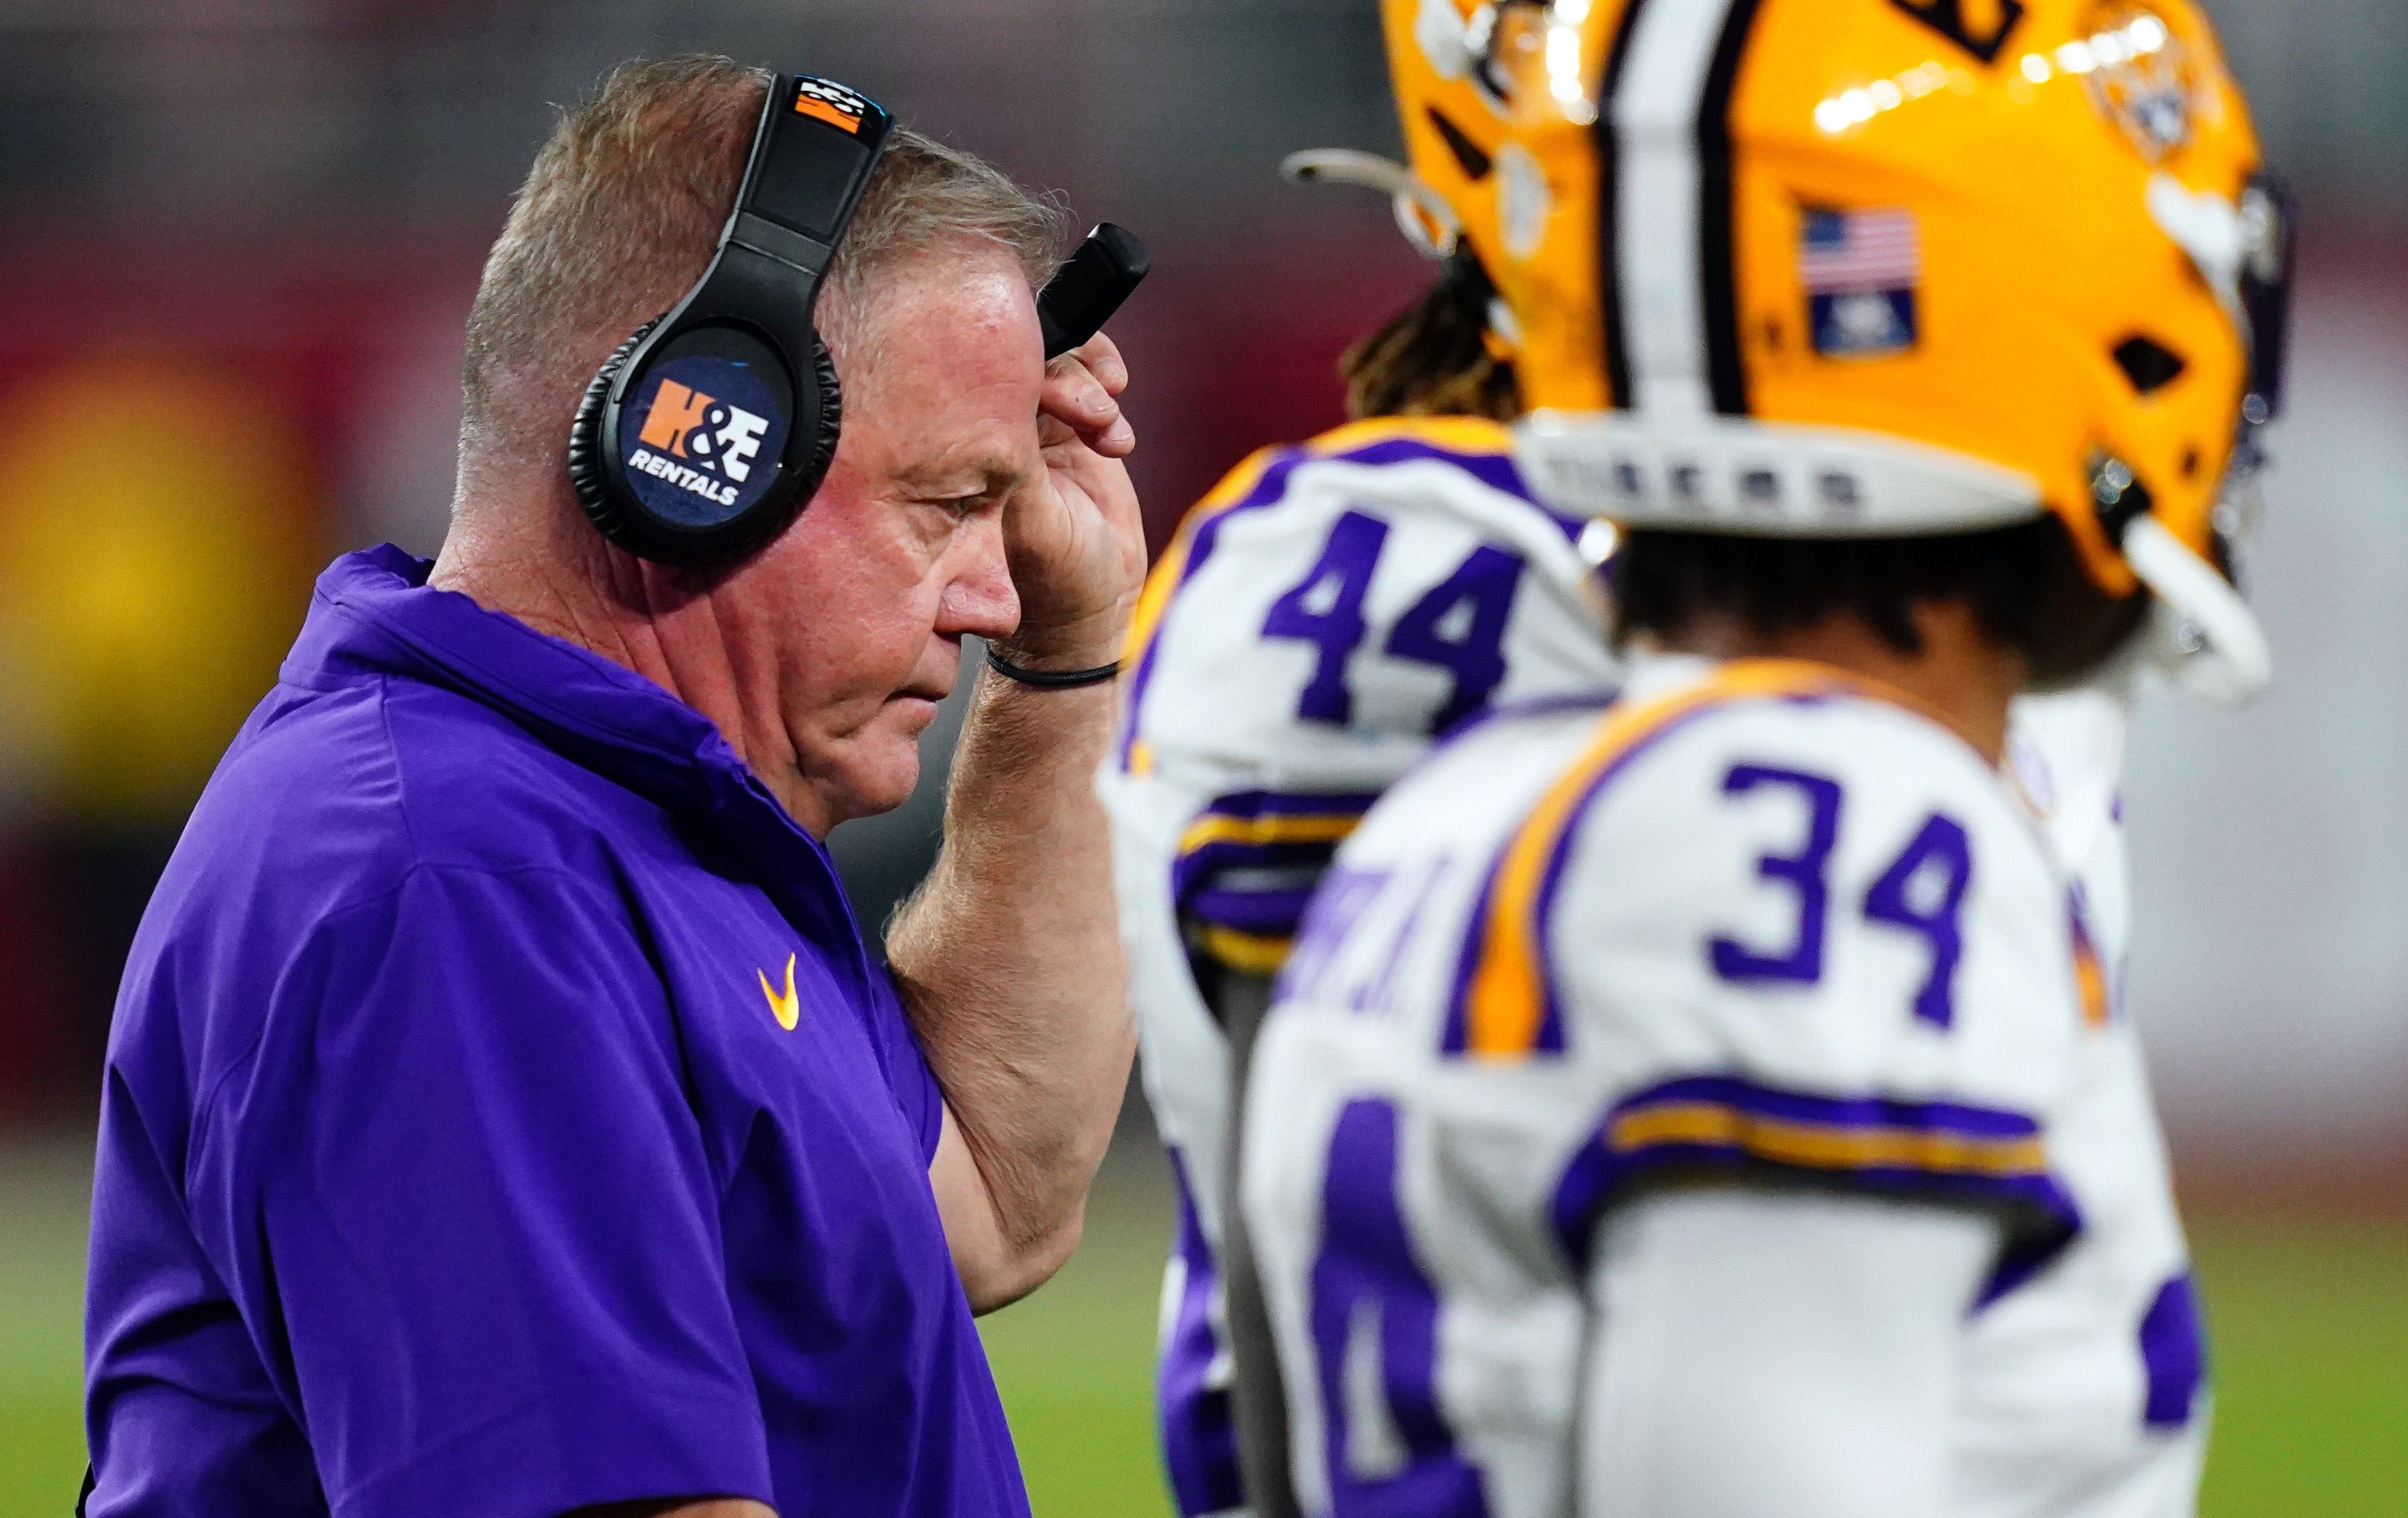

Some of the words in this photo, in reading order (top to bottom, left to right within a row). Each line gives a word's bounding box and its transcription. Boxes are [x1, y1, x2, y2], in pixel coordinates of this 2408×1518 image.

[628, 448, 739, 507] RENTALS
[1261, 510, 1526, 742] 44
[1710, 764, 1971, 1028] 34
